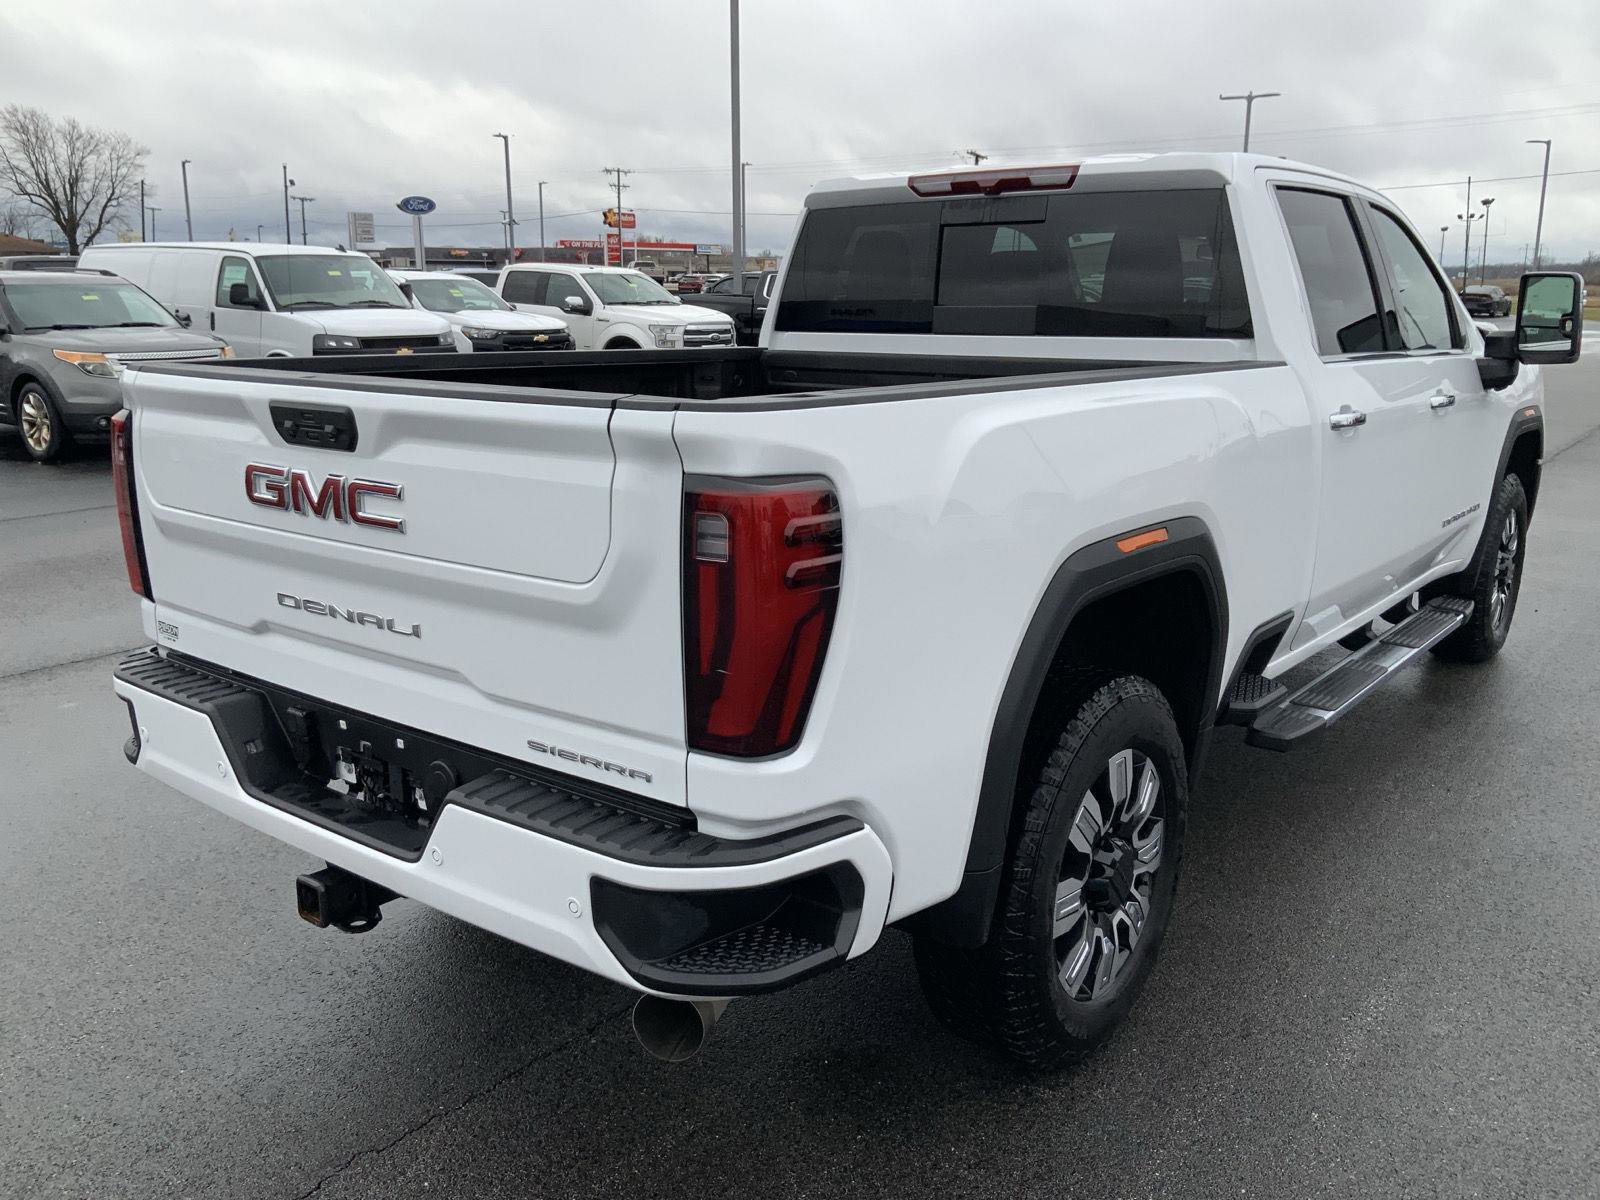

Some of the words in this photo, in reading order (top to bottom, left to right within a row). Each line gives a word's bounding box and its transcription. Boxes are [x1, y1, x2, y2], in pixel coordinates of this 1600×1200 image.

[408, 199, 430, 211] Ford
[245, 462, 406, 534] GMC
[278, 592, 422, 639] DENALI
[527, 739, 653, 783] SIERRA
